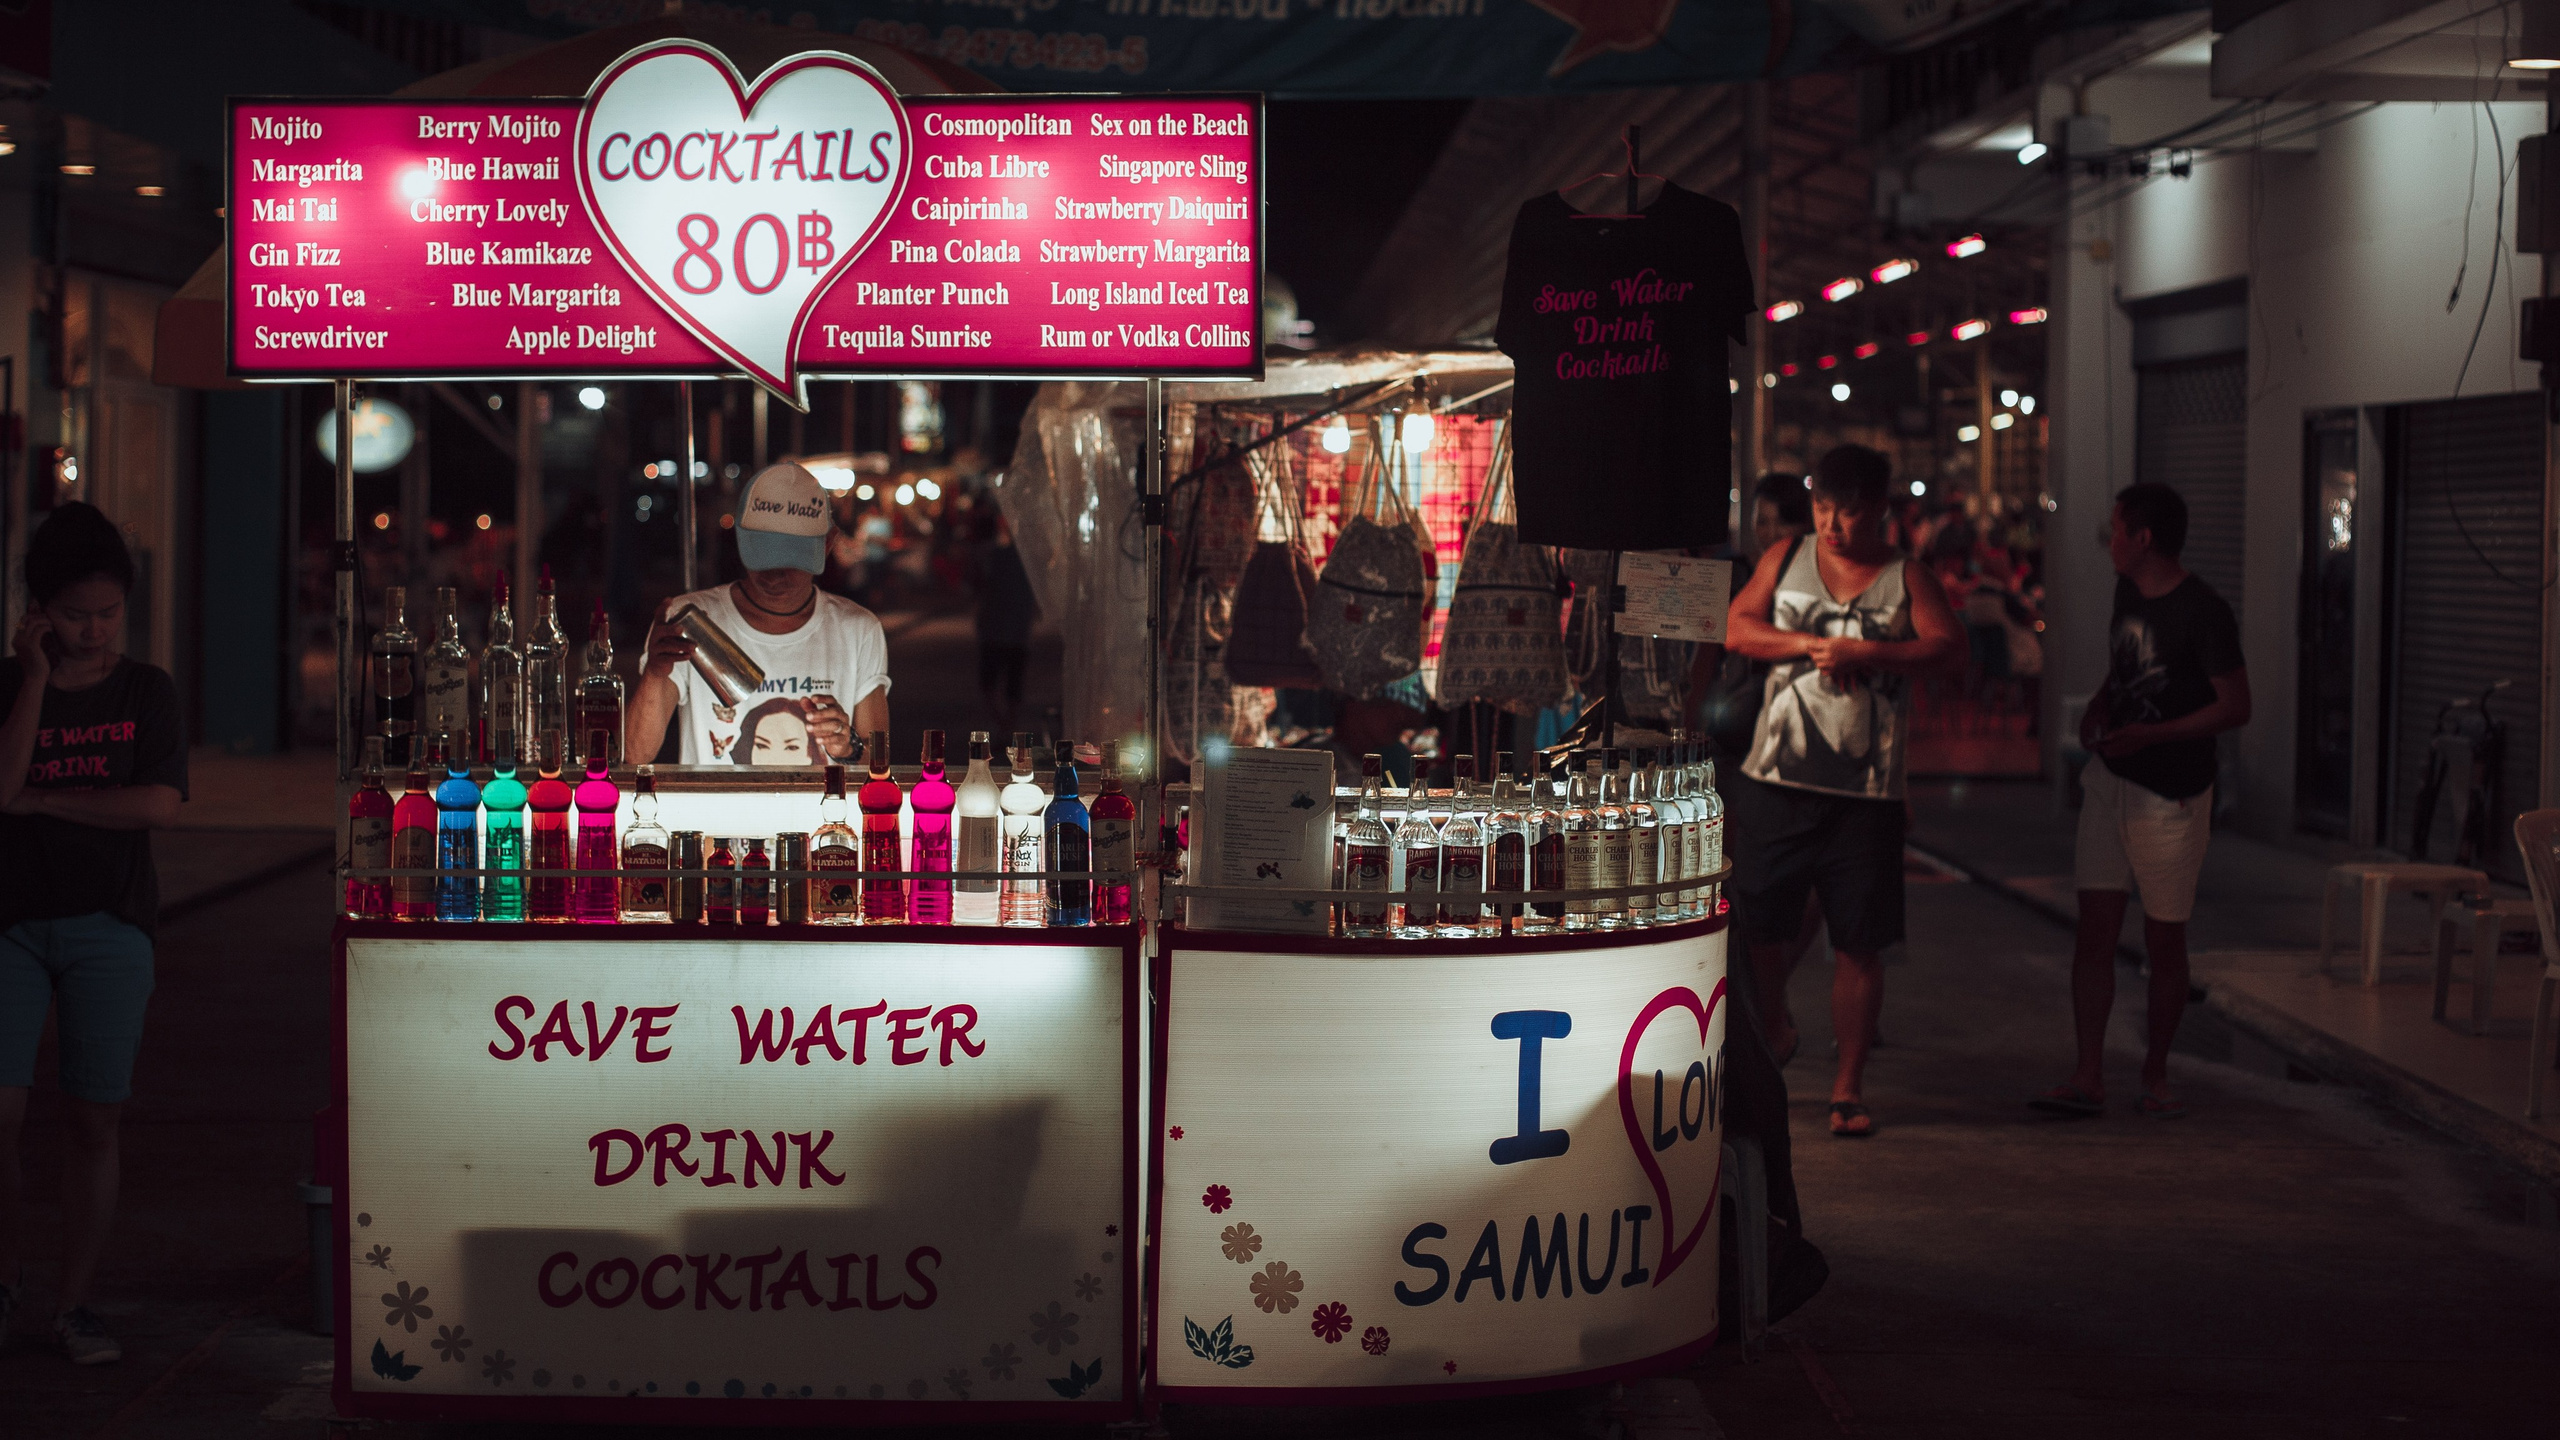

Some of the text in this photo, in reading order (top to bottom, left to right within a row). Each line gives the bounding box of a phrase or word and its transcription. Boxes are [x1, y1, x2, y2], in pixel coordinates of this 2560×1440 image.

[252, 117, 321, 144] Mojito
[420, 116, 560, 143] Berry Mojito
[925, 113, 1071, 141] Cosmopolitan
[1091, 114, 1248, 135] Sex on the Beach
[427, 157, 558, 181] Blue Hawaii
[597, 126, 893, 186] COCKTAILS
[926, 155, 1050, 179] Cuba Libre
[1100, 155, 1247, 183] Singapore Sling
[253, 158, 362, 187] Margarita
[253, 197, 337, 222] Mai Tai
[410, 198, 568, 227] Cherry Lovely
[912, 194, 1028, 226] Caipirinha
[1055, 196, 1247, 226] Strawberry Daiquiri
[250, 243, 340, 266] Gin Fizz
[427, 242, 591, 264] Blue Kamikaze
[891, 240, 1020, 262] Pina Colada
[1040, 239, 1250, 269] Strawberry Margarita
[252, 284, 365, 312] Tokyo Tea
[454, 283, 620, 311] Blue Margarita
[858, 282, 1008, 304] Planter Punch
[1052, 282, 1248, 311] Long Island Iced Tea
[1533, 267, 1694, 315] Save Water
[256, 326, 387, 348] Screwdriver
[507, 325, 656, 354] Apple Delight
[824, 325, 991, 353] Tequila Sunrise
[1041, 325, 1249, 347] Rum or Vodka Collins
[1574, 311, 1655, 346] Drink
[1556, 344, 1673, 381] Cocktails
[752, 498, 823, 519] Save Water
[60, 721, 136, 747] WATER
[30, 755, 110, 782] DRINK
[488, 995, 986, 1067] SAVE WATER
[1489, 1009, 1573, 1166] I
[588, 1123, 846, 1189] DRINK
[1394, 1205, 1653, 1307] SAMUI
[538, 1245, 942, 1311] COCKTAILS
